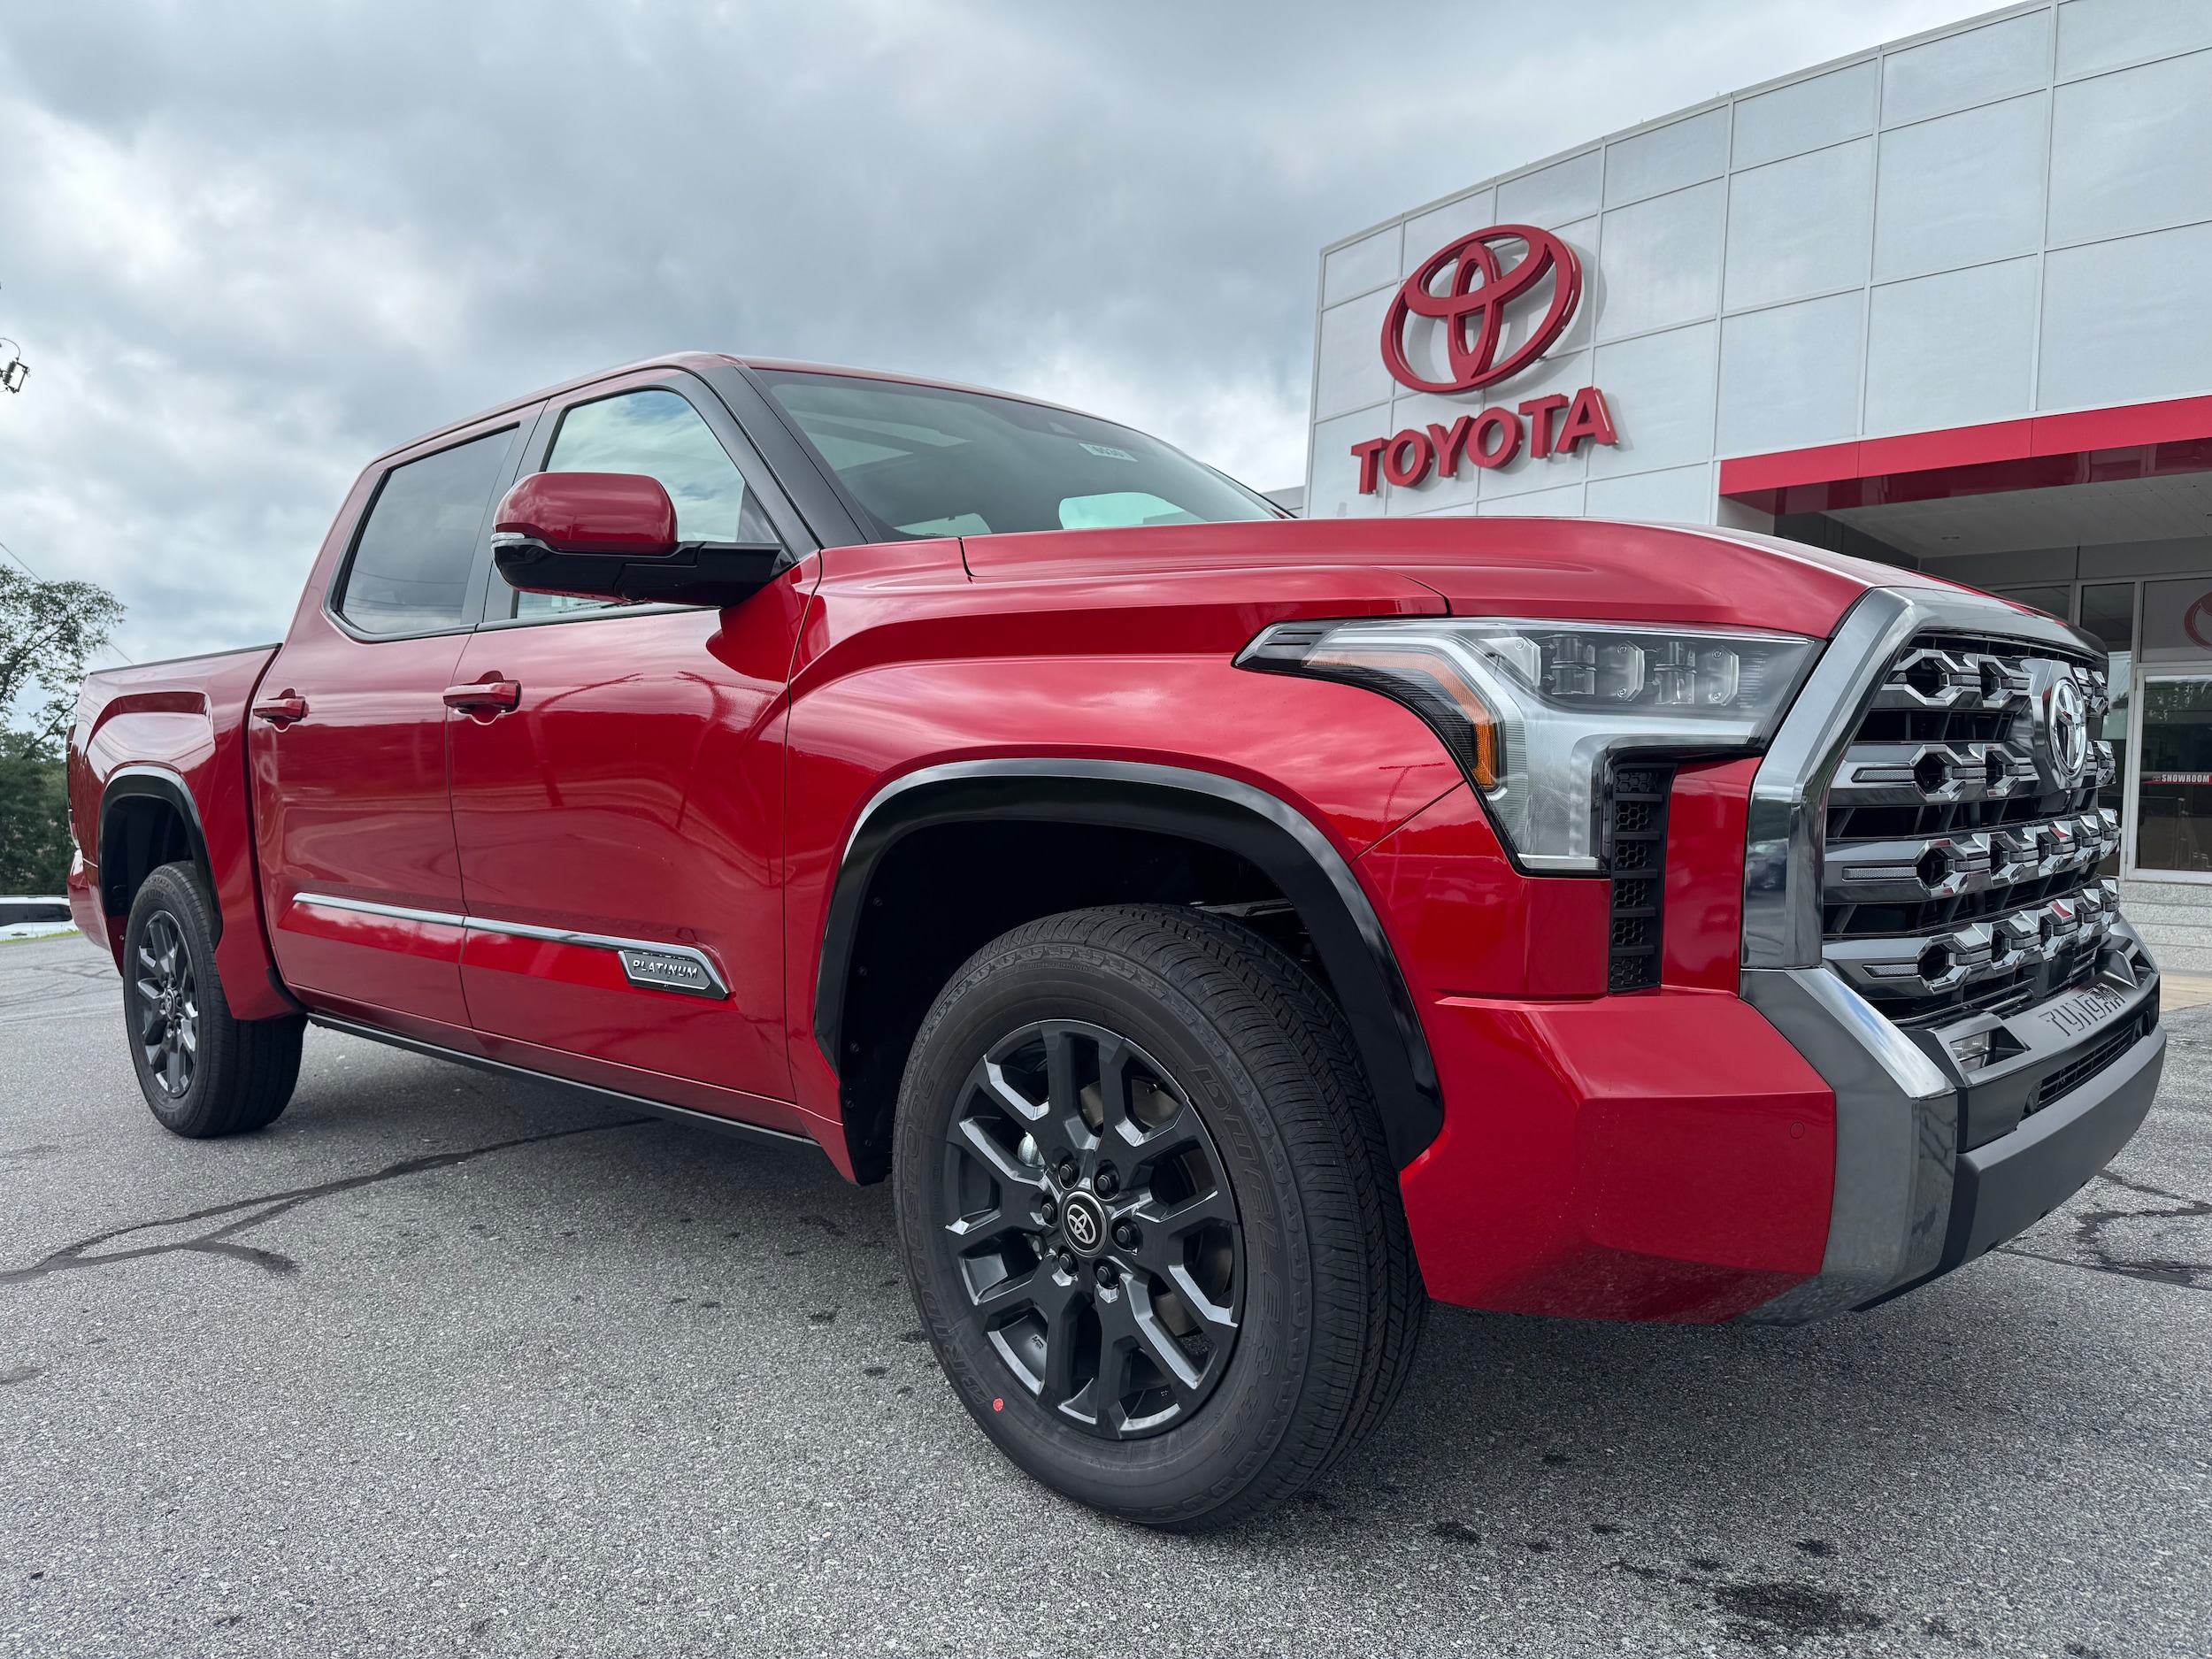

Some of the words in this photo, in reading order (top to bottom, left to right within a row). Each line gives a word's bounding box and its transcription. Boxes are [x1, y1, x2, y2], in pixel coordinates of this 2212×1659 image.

[1351, 386, 1619, 495] TOYOTA
[2162, 774, 2210, 783] SHOWROOM
[633, 958, 698, 979] PLATINUM
[2039, 982, 2126, 1037] TUNDRA
[902, 1064, 990, 1408] BRIDGESTONE
[1190, 1065, 1284, 1379] DUELER
